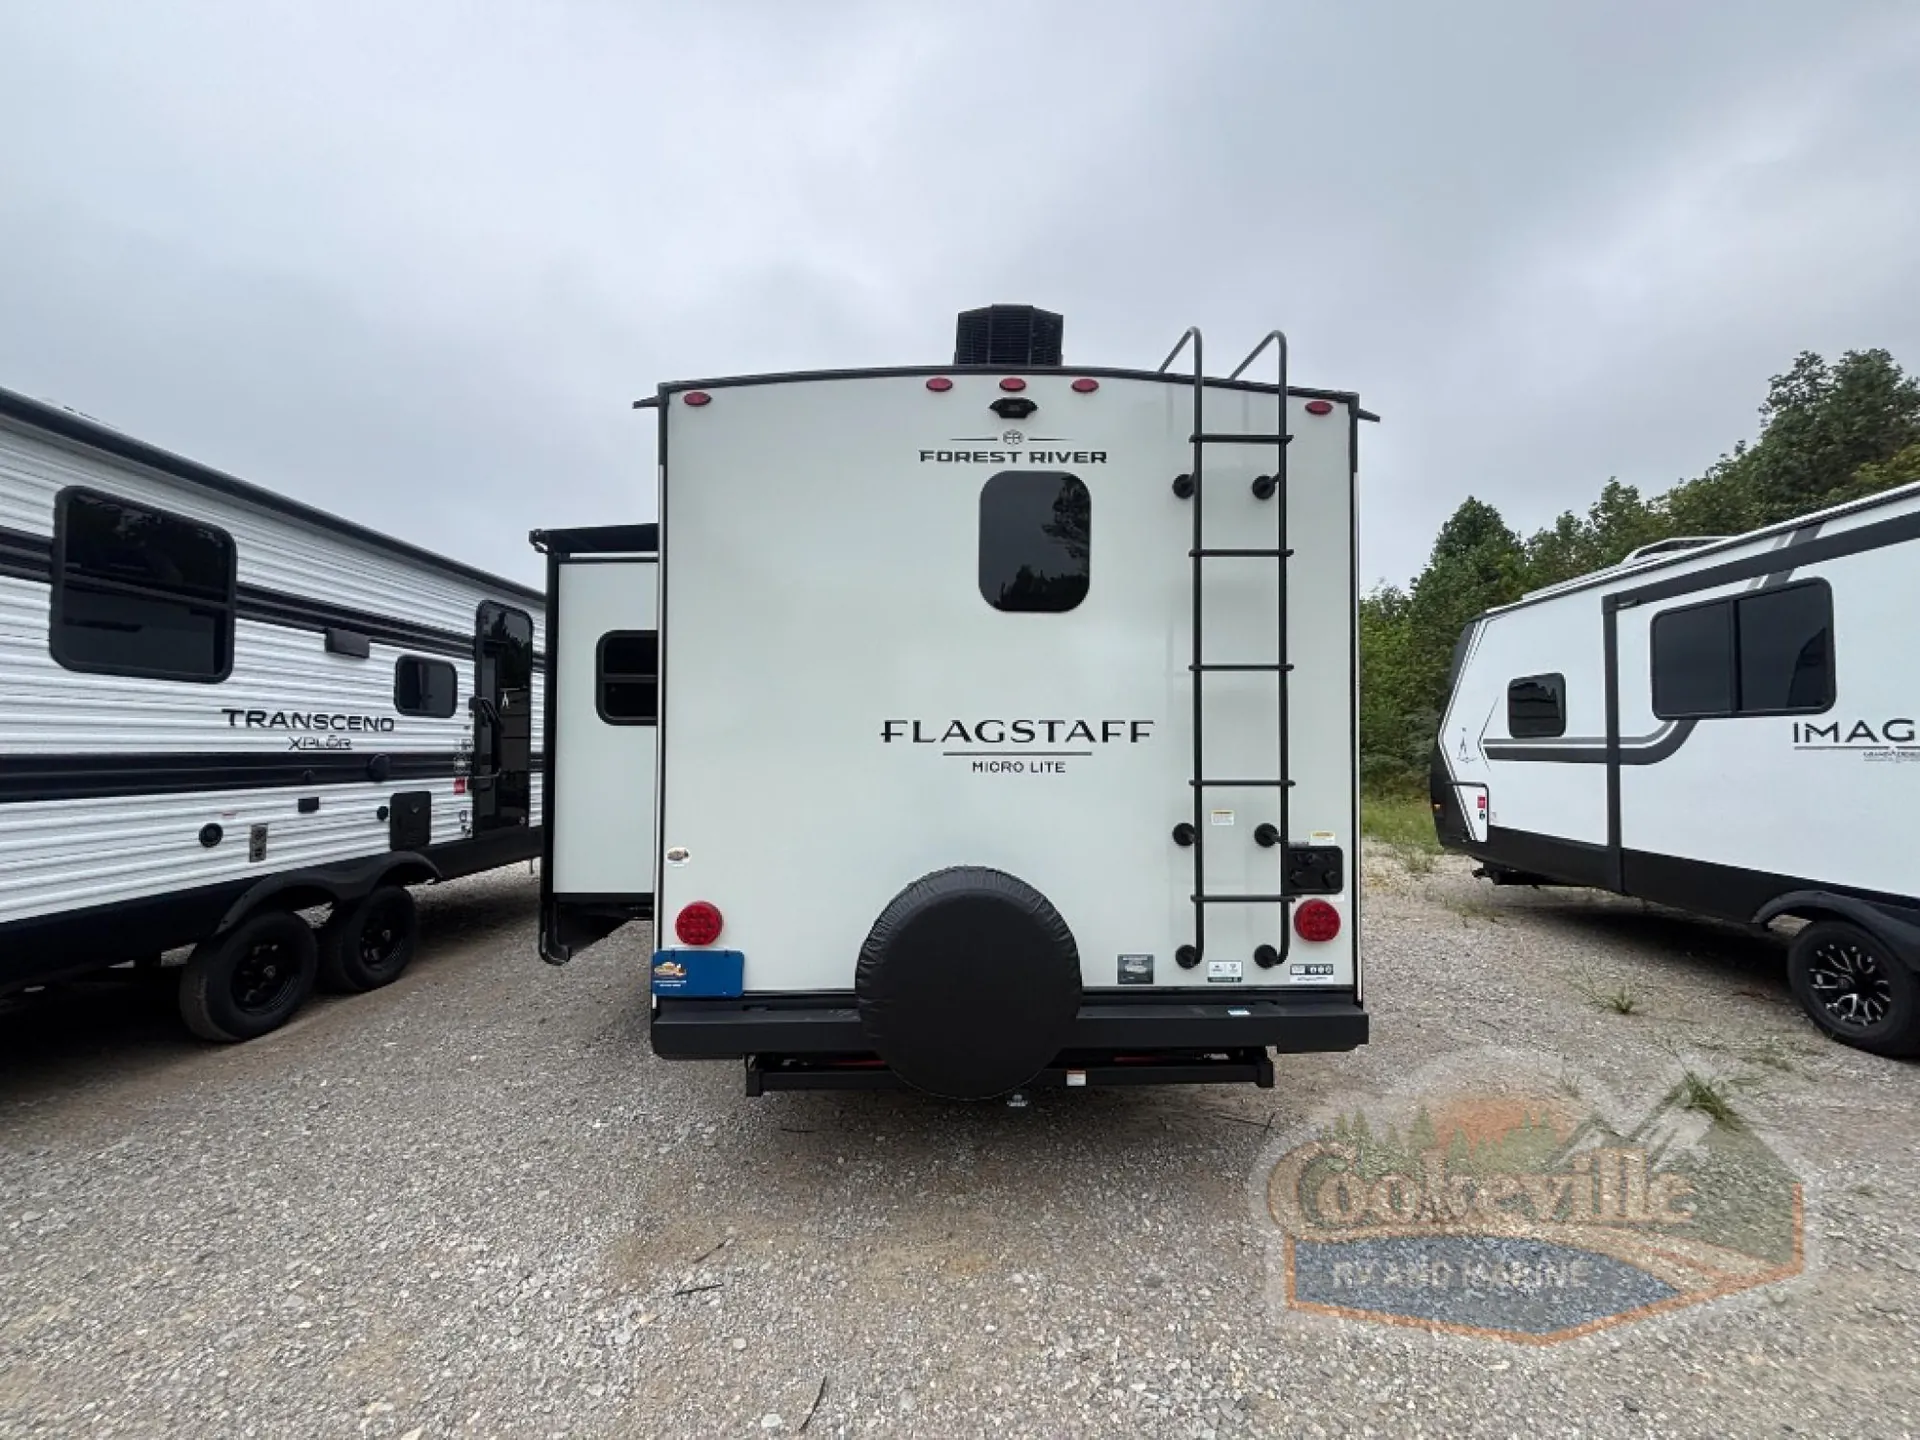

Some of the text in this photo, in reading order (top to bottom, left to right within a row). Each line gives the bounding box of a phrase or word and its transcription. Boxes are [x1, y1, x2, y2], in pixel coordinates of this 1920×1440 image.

[919, 450, 1107, 464] FOREST RIVER
[221, 708, 395, 732] TRANSCEND
[879, 719, 1155, 743] FLAGSTAFF
[972, 761, 1066, 773] MICRO LITE
